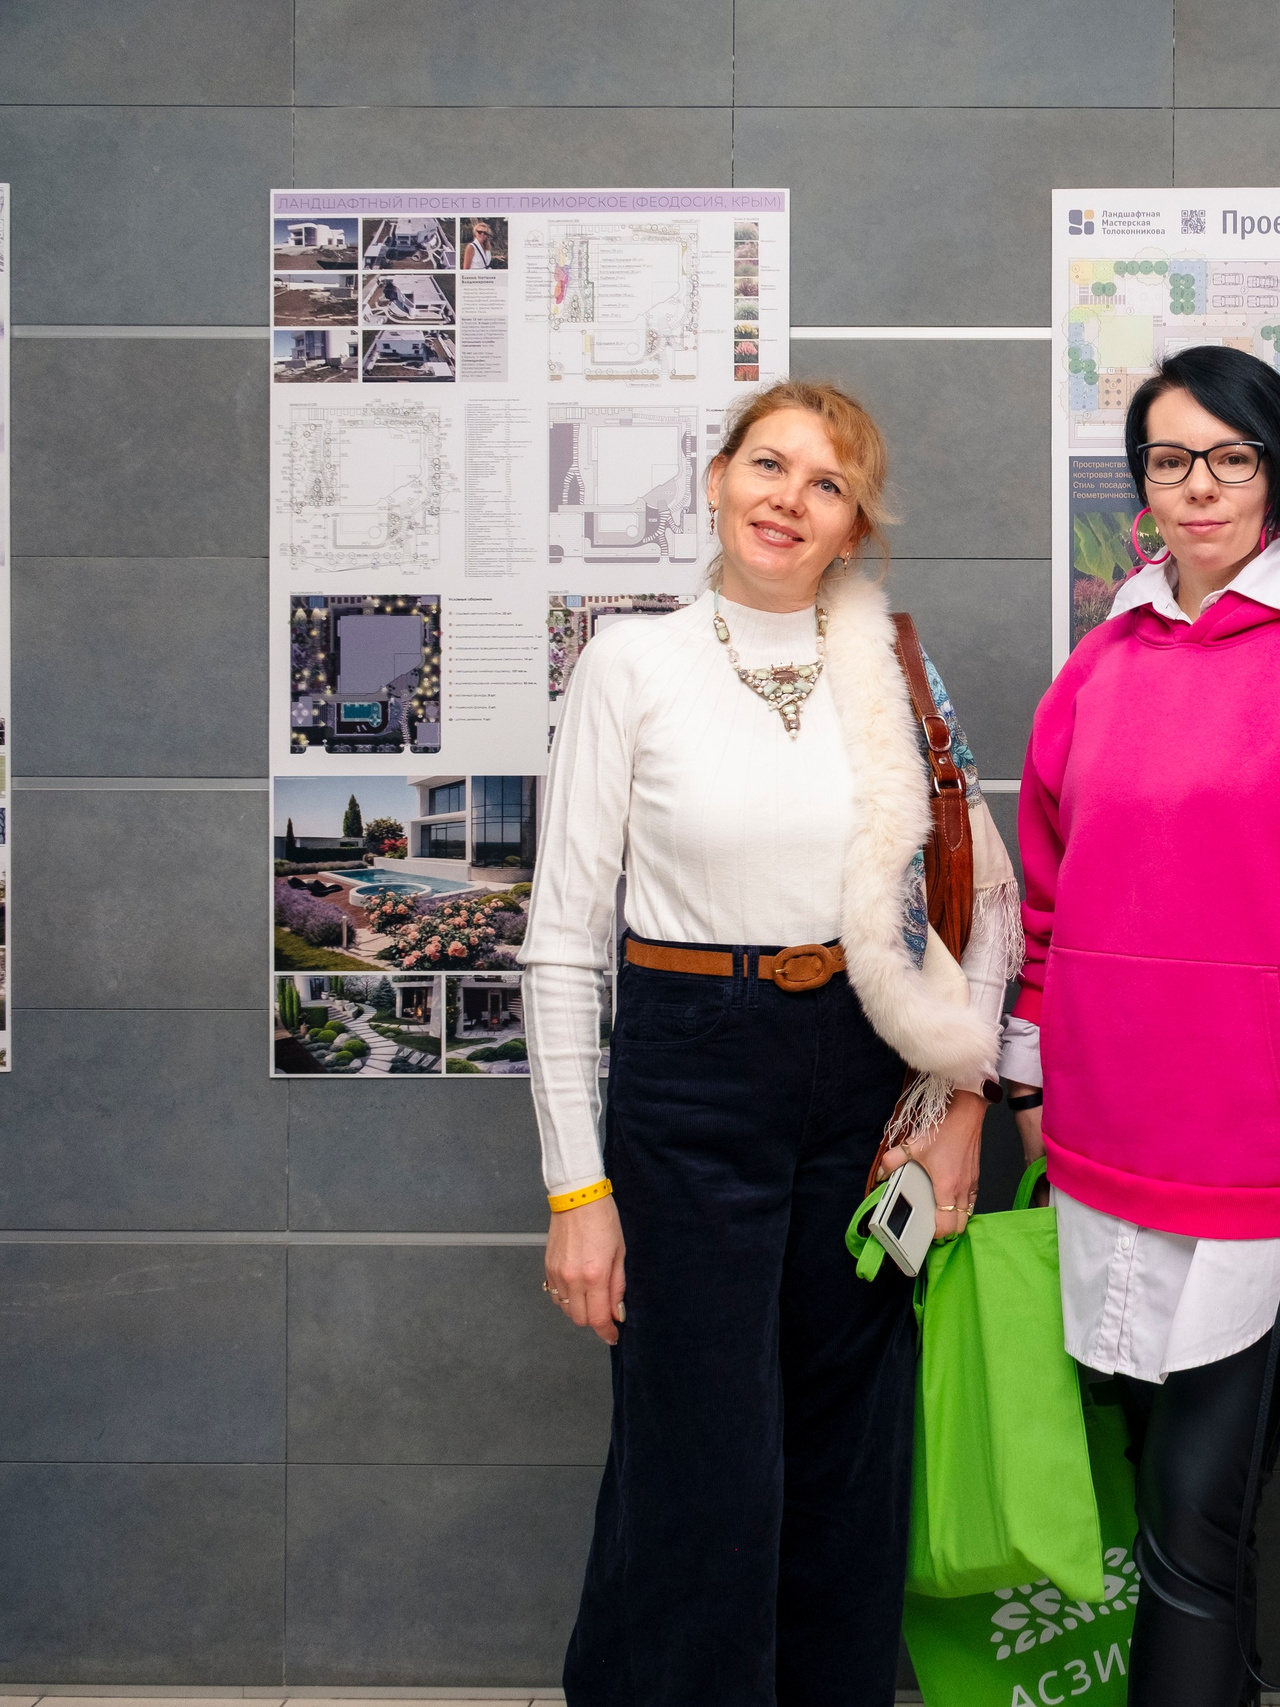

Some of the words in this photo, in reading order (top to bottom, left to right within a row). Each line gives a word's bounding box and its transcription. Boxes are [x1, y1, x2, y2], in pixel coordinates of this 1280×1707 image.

[278, 194, 403, 213] ЛАНДШАФТНЫЙ
[408, 197, 468, 213] ПРОЕКТ
[472, 194, 481, 209] В
[520, 196, 628, 212] ПРИМОРСКОЕ
[632, 195, 727, 210] (ФЕОДОСИЯ,
[731, 196, 781, 209] КРЫМ)
[1101, 210, 1160, 219] Ландшафтная
[1102, 219, 1151, 227] Мастерская
[1102, 227, 1166, 235] Толоконникова
[1073, 460, 1127, 469] Пространство
[1073, 481, 1095, 489] Стиль
[1099, 482, 1131, 490] посадок
[1073, 491, 1135, 500] Геометричность
[1011, 1638, 1131, 1707] АСЗИ
